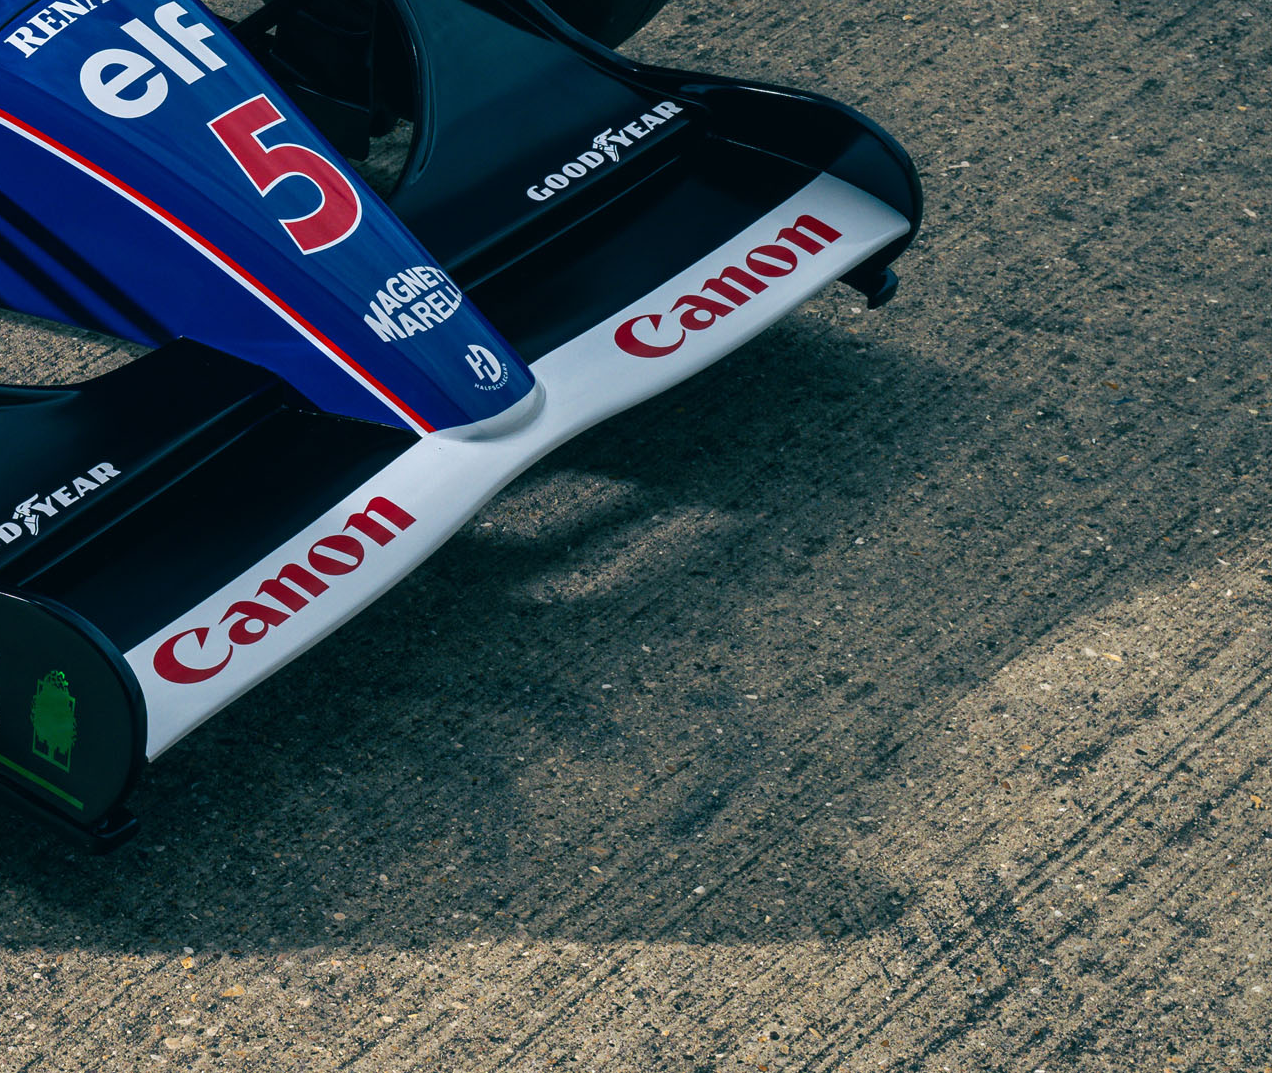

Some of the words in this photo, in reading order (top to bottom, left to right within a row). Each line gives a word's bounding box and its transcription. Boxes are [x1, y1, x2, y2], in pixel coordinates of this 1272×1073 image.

[79, 0, 228, 119] elf
[206, 93, 362, 255] 5
[614, 214, 843, 359] Canon
[153, 496, 417, 684] Canon
